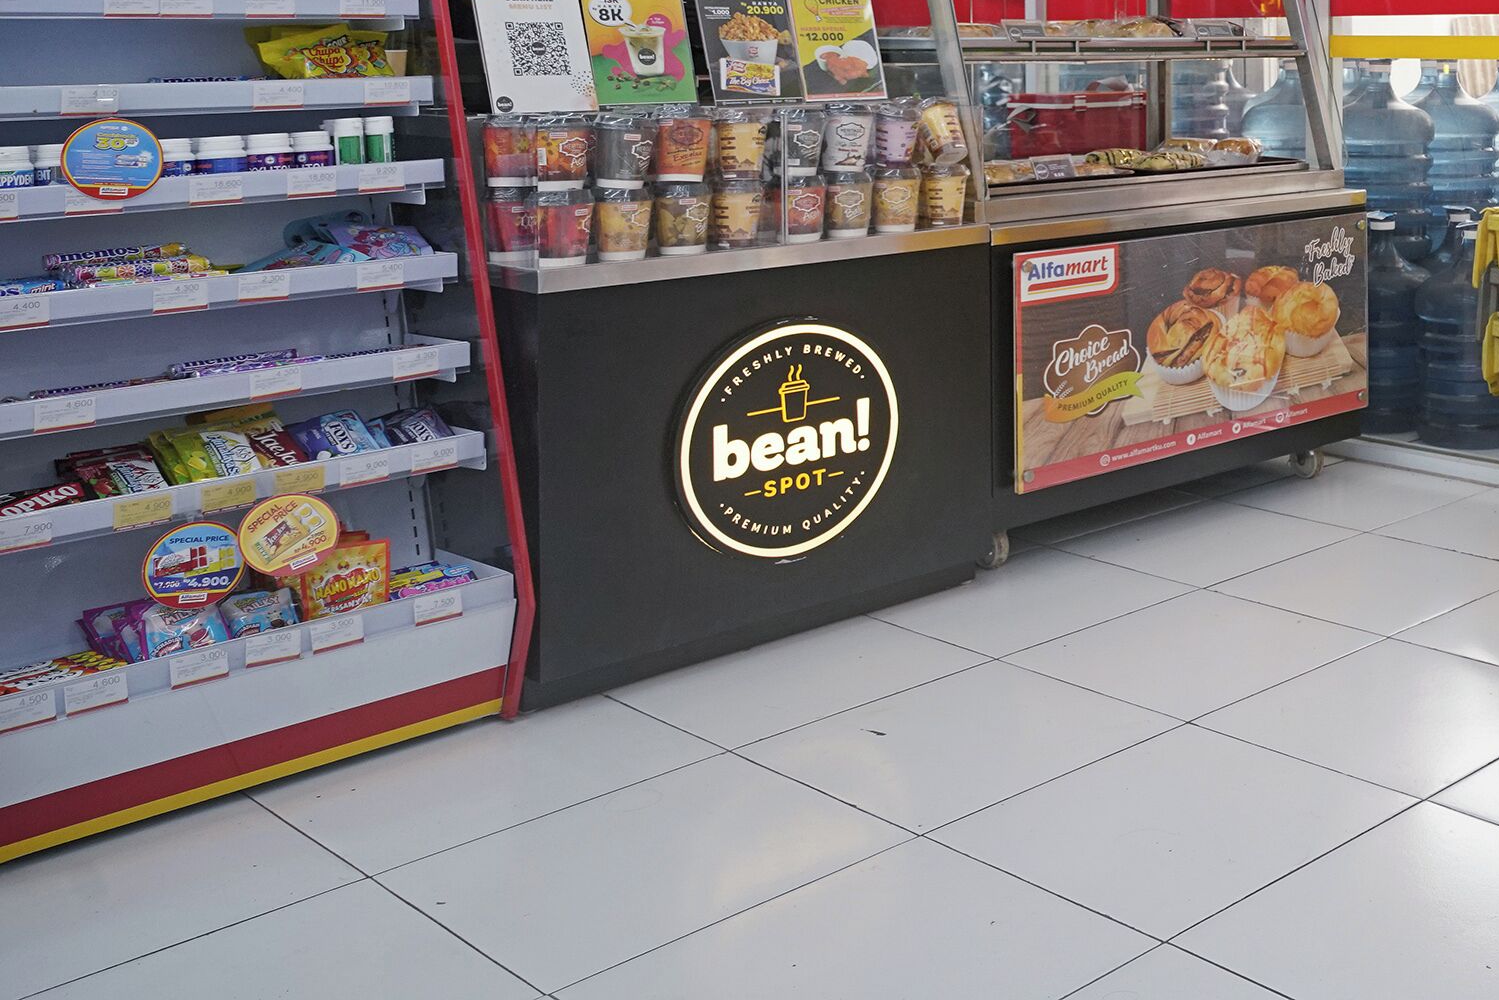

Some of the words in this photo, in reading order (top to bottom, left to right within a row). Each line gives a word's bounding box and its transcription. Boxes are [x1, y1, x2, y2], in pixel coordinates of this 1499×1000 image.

[598, 8, 625, 22] 8K
[746, 4, 784, 16] 20.900
[308, 45, 342, 57] Chupa
[805, 32, 844, 42] 12.000
[59, 246, 141, 262] mentos
[1027, 253, 1109, 282] Alfamart
[29, 281, 57, 294] mint
[724, 345, 794, 397] FRESHLY
[802, 343, 862, 376] BREWED
[1054, 335, 1112, 377] Choice
[1083, 343, 1131, 385] Bread
[1057, 393, 1095, 413] PREMIUM
[1095, 377, 1129, 402] QUALITY
[712, 396, 871, 482] bean!
[1196, 427, 1224, 442] Alfamart
[1241, 417, 1268, 431] Alfamart
[1284, 406, 1309, 421] Alfamart
[763, 467, 827, 498] SPOT
[247, 502, 284, 533] SPECIAL
[273, 499, 299, 522] PRICE
[723, 504, 793, 536] PREMIUM
[801, 475, 862, 530] QUALITY
[169, 535, 204, 545] SPECIAL
[205, 534, 231, 543] PRICE
[315, 578, 347, 599] NANO
[349, 565, 383, 589] NANO
